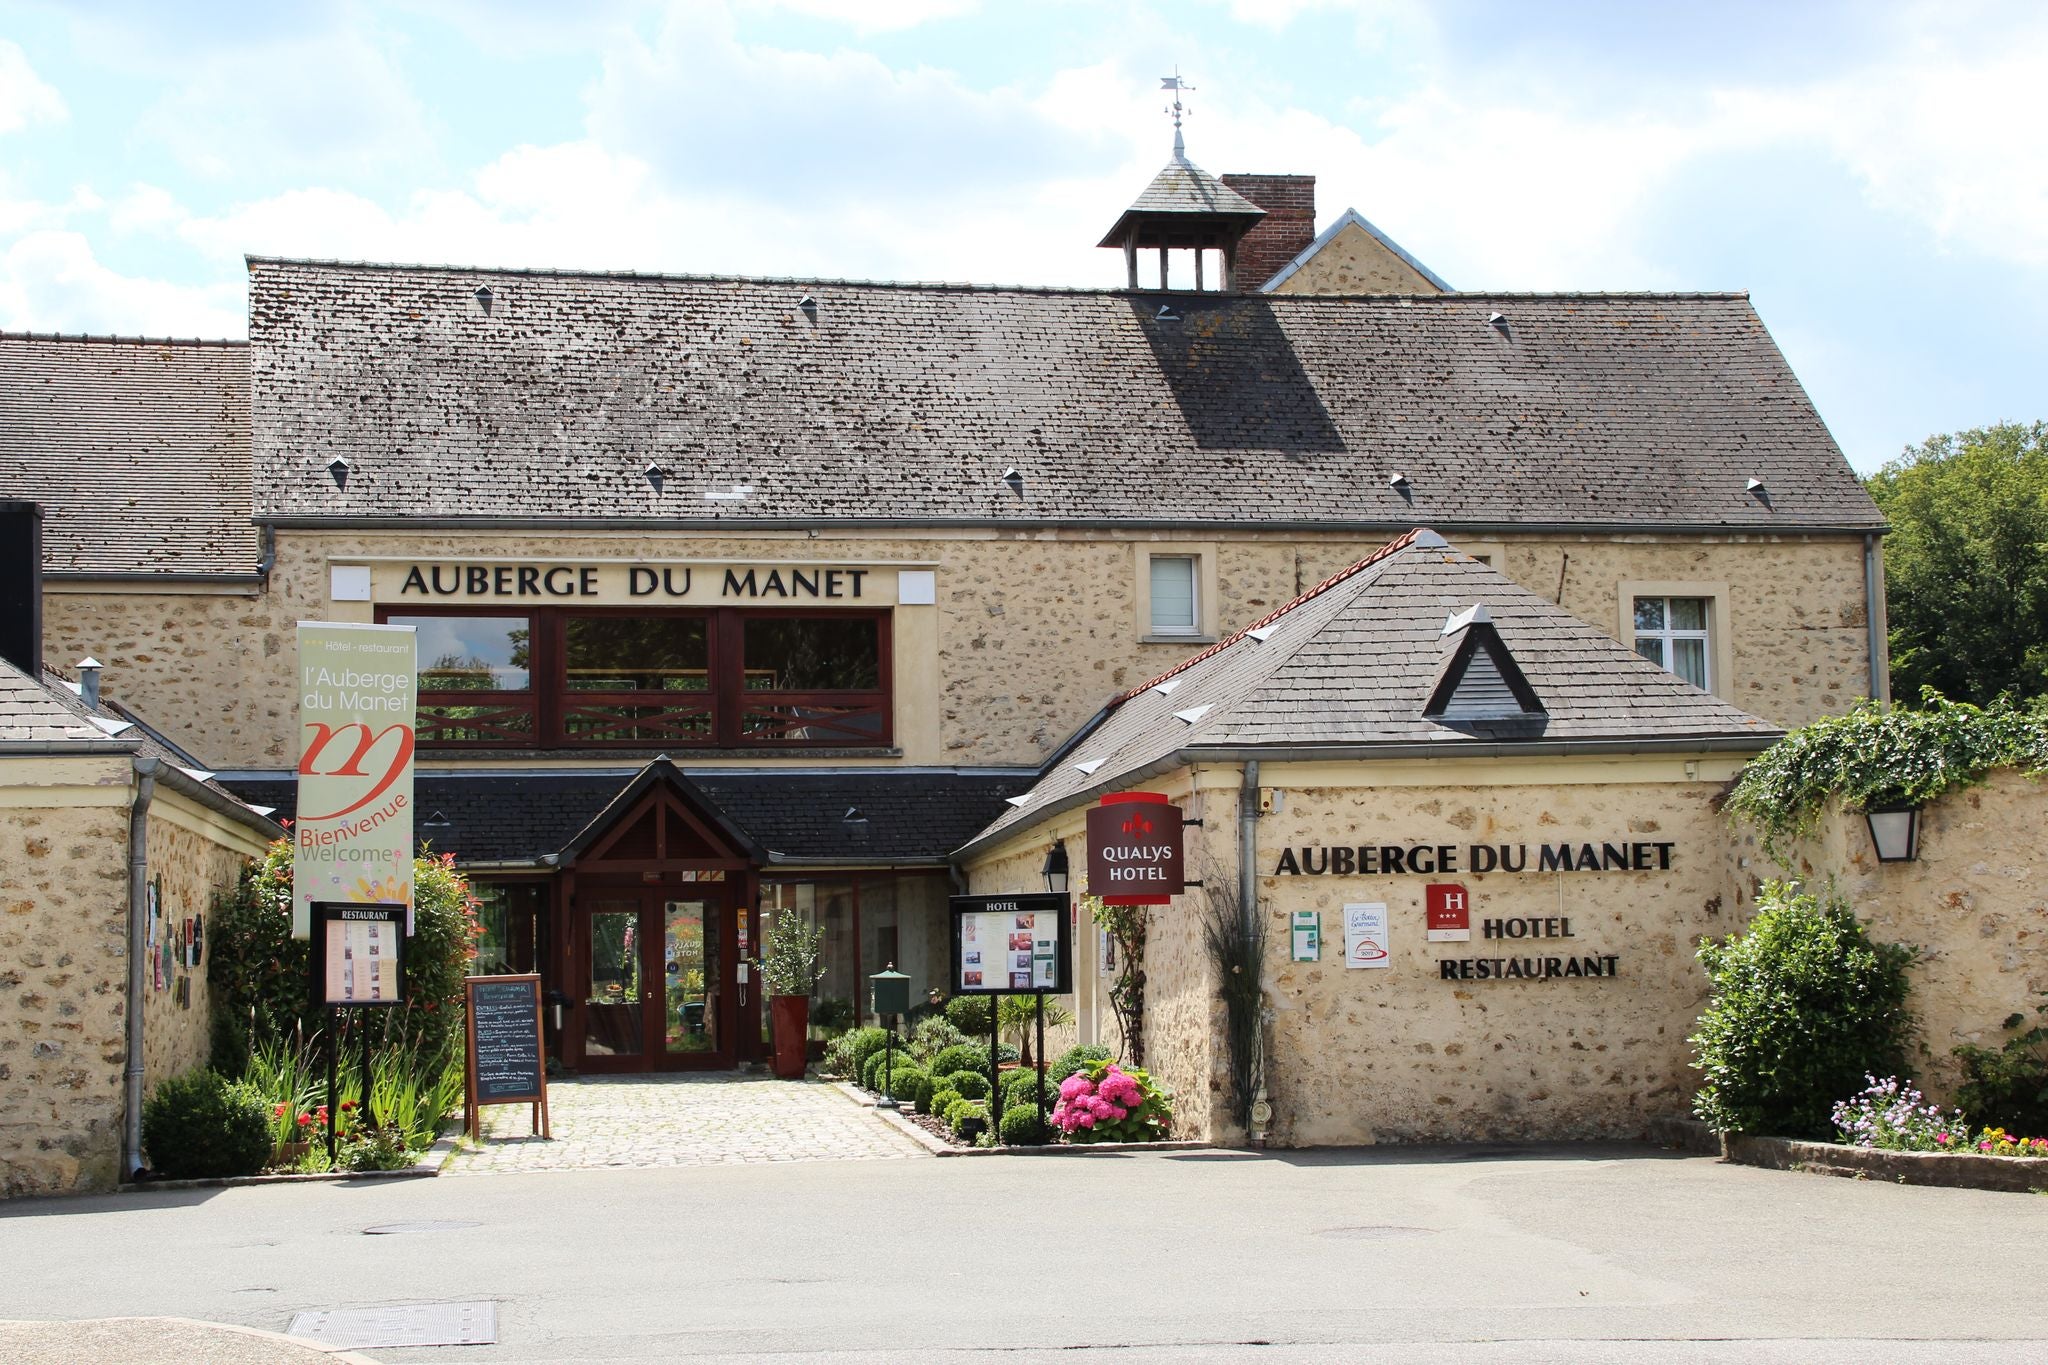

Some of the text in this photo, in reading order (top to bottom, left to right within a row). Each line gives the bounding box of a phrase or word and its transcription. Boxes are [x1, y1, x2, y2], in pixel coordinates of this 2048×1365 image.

[401, 566, 868, 597] AUBERGE DU MANET
[325, 640, 351, 652] Hôtel
[358, 643, 409, 654] restaurant
[304, 690, 409, 711] du Manet
[301, 794, 408, 847] Bienvenue
[302, 844, 393, 862] Welcome
[1274, 842, 1675, 876] AUBERGE DU MANET
[1110, 867, 1167, 881] HOTEL
[986, 902, 1020, 911] HOTEL
[1444, 892, 1465, 910] H
[342, 910, 389, 920] RESTAURANT
[1483, 917, 1575, 939] HOTEL
[1440, 956, 1620, 980] RESTAURANT
